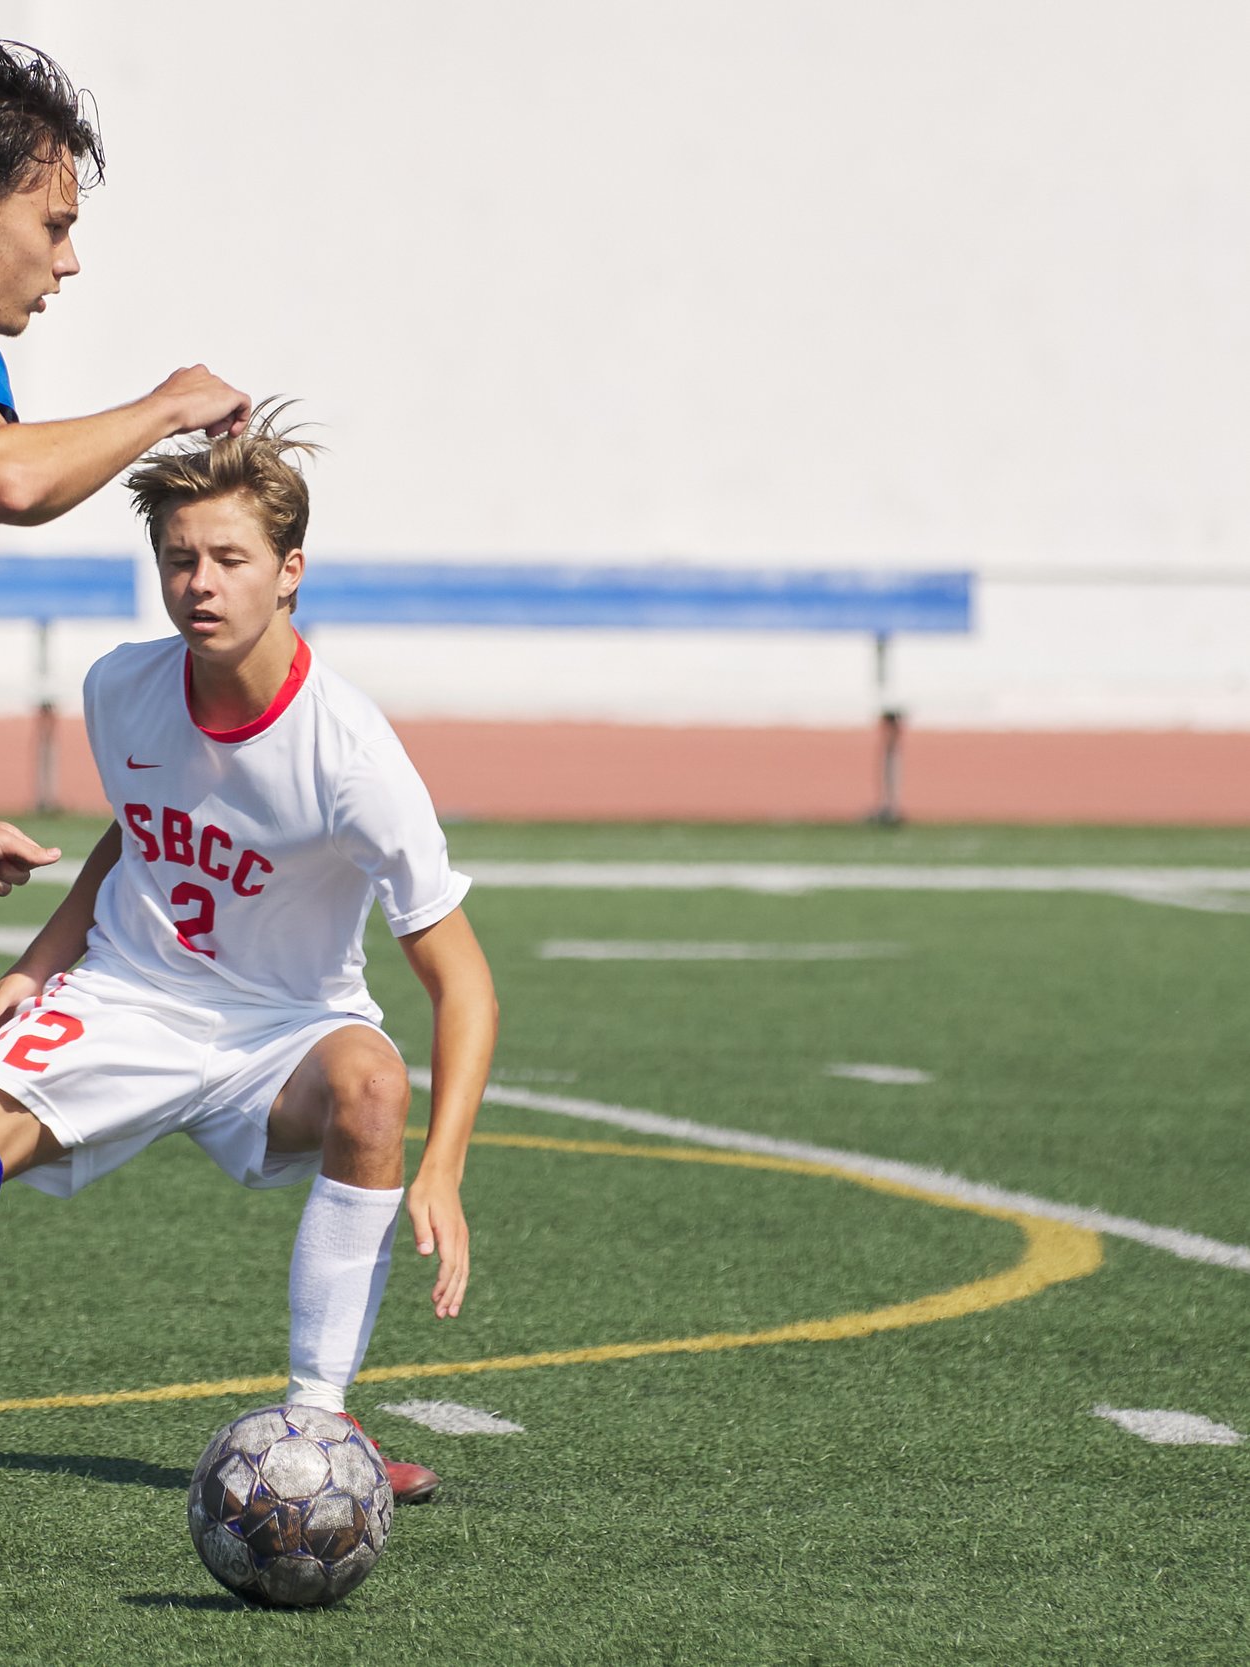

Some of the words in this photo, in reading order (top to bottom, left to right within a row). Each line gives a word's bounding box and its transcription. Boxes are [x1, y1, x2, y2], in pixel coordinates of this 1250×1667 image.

[124, 803, 274, 897] SBCC
[170, 881, 217, 960] 2
[2, 1010, 85, 1073] 2
